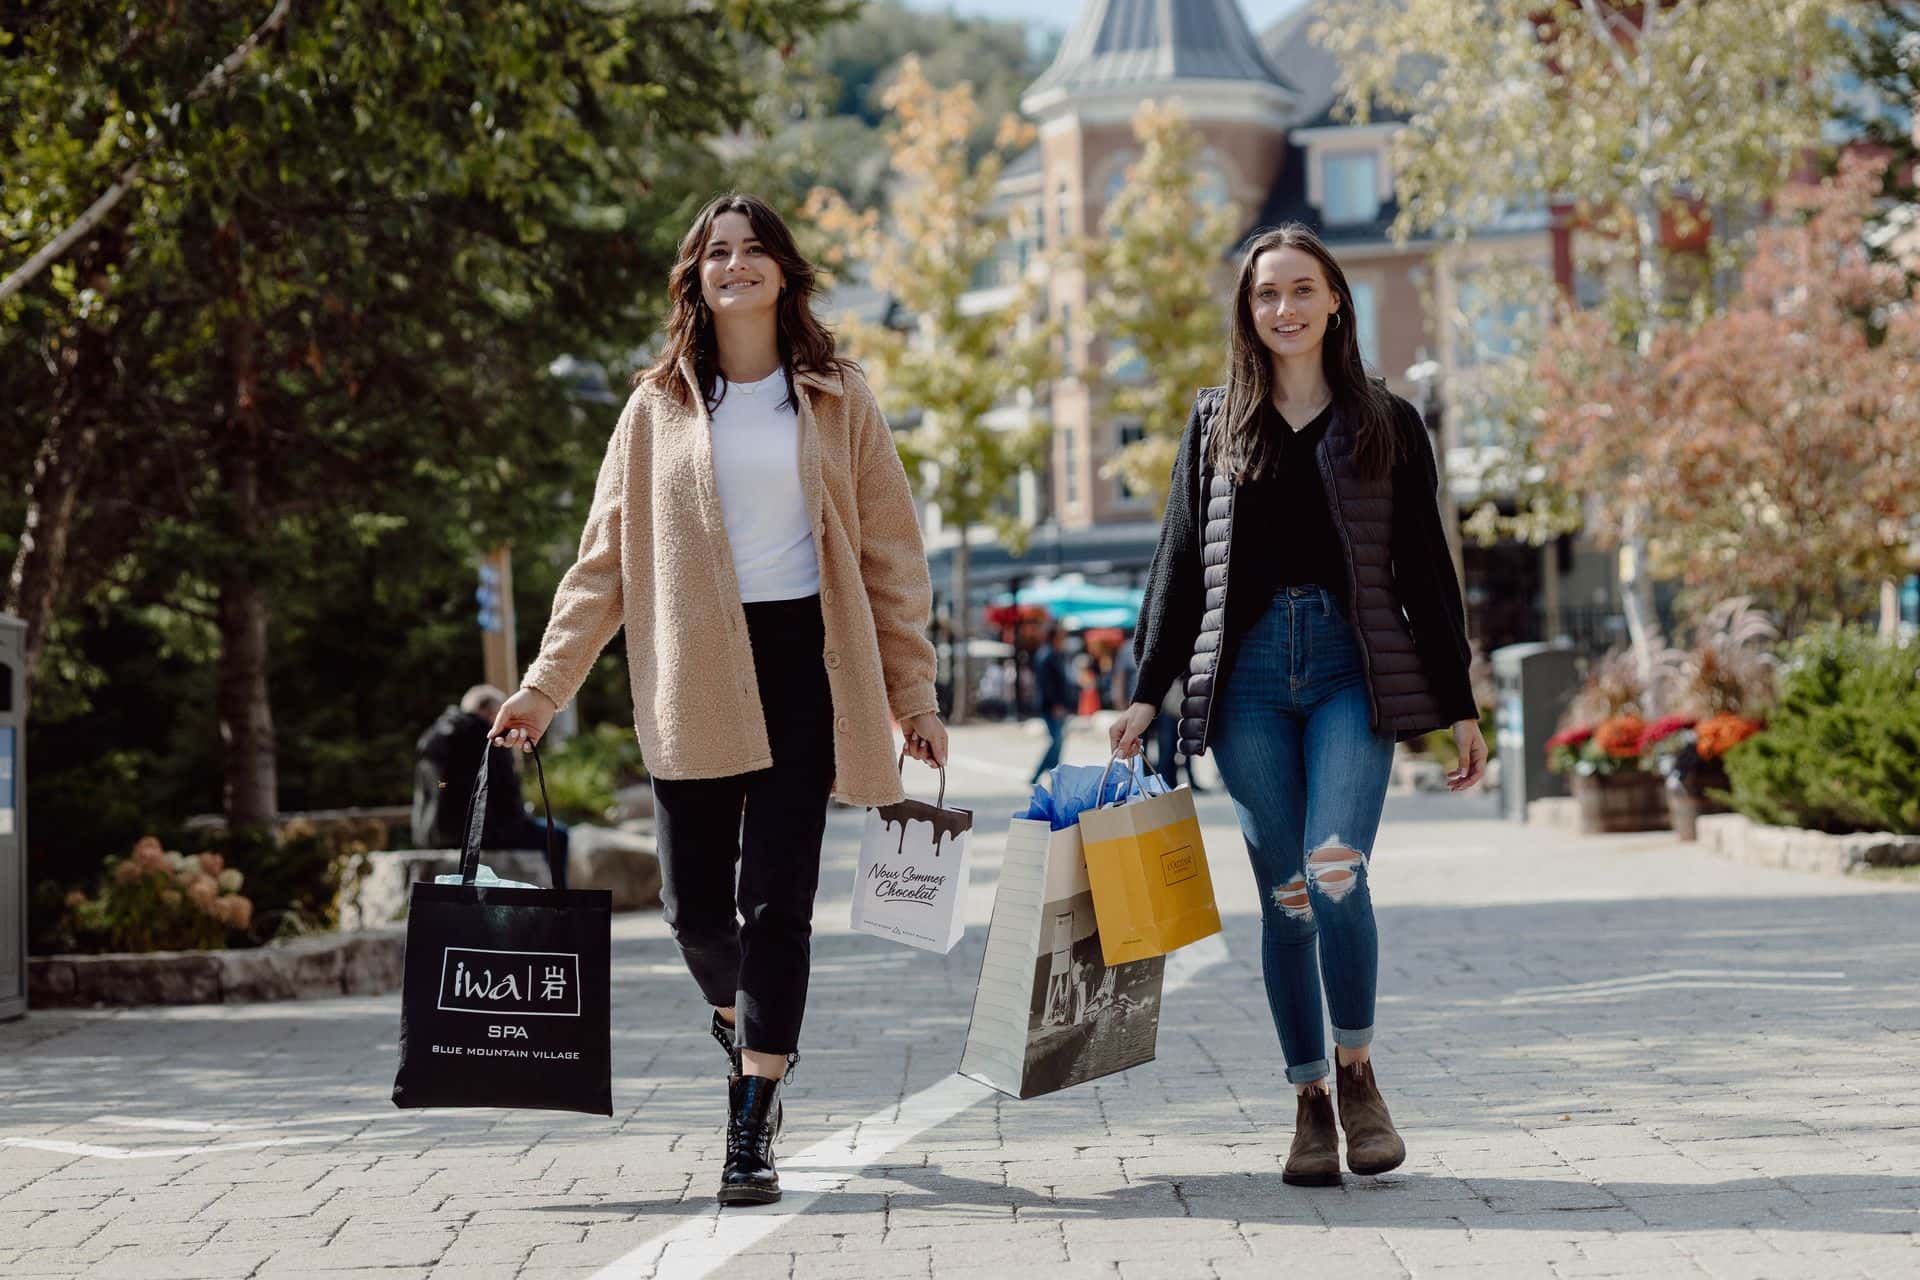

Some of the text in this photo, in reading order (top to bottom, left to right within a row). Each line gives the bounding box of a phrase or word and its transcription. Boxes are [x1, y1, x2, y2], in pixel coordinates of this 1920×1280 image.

[868, 863, 946, 886] Nous Sommes
[875, 880, 939, 901] Chocolat
[455, 961, 522, 1001] iwa
[540, 965, 567, 1001] 岩
[487, 1025, 529, 1039] SPA
[432, 1044, 580, 1060] BLUE MOUNTAIN VILLAGE
